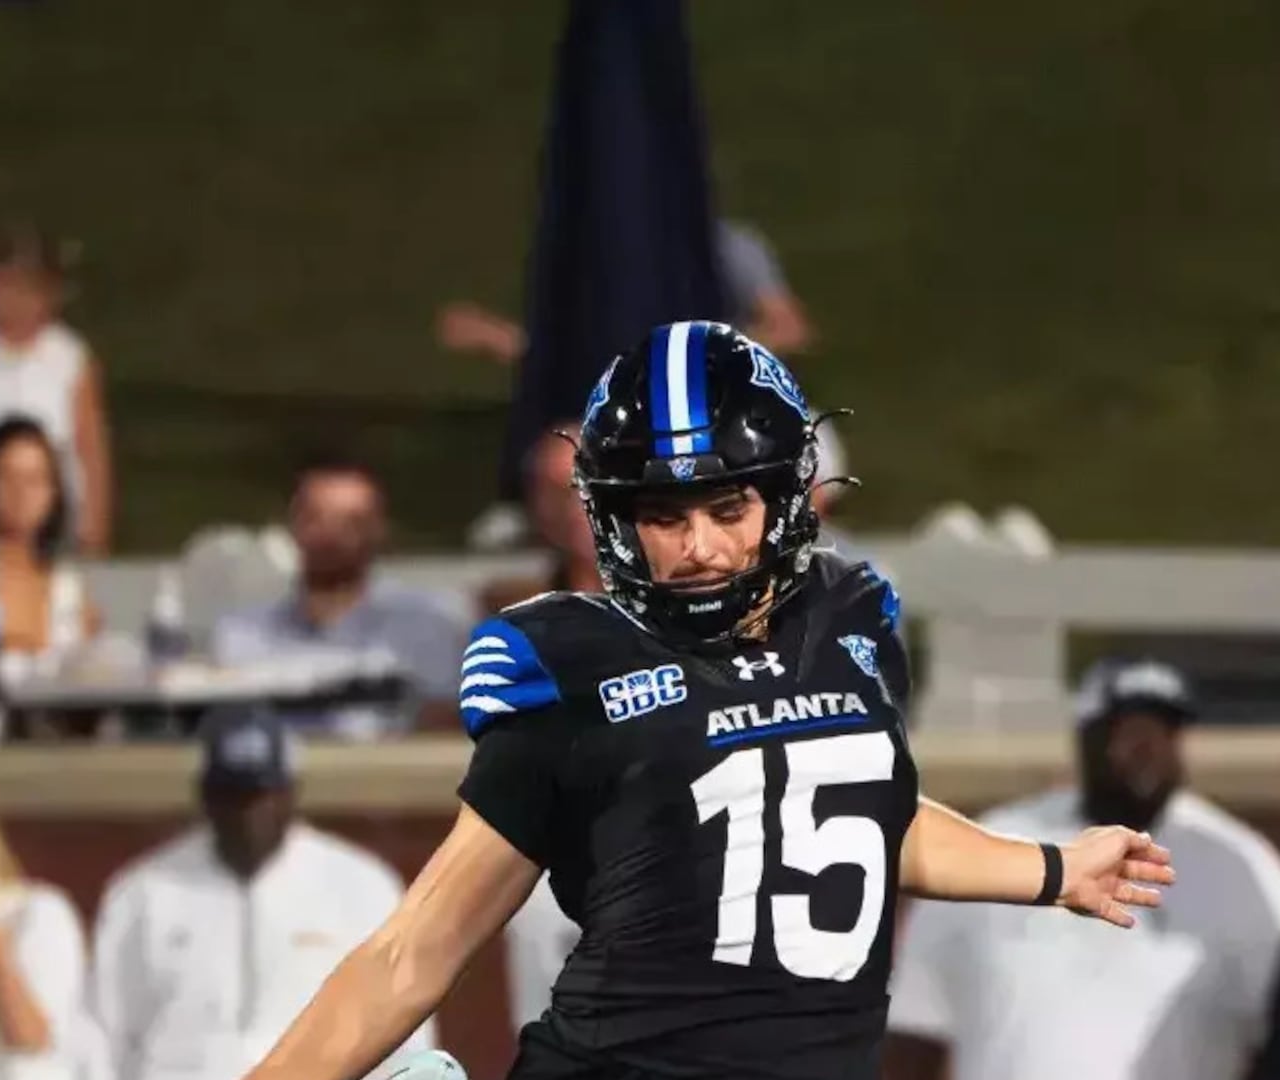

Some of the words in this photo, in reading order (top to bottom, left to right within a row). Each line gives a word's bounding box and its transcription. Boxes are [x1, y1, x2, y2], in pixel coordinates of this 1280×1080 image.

[599, 664, 687, 722] SBC
[706, 692, 868, 736] ATLANTA
[689, 731, 895, 982] 15
